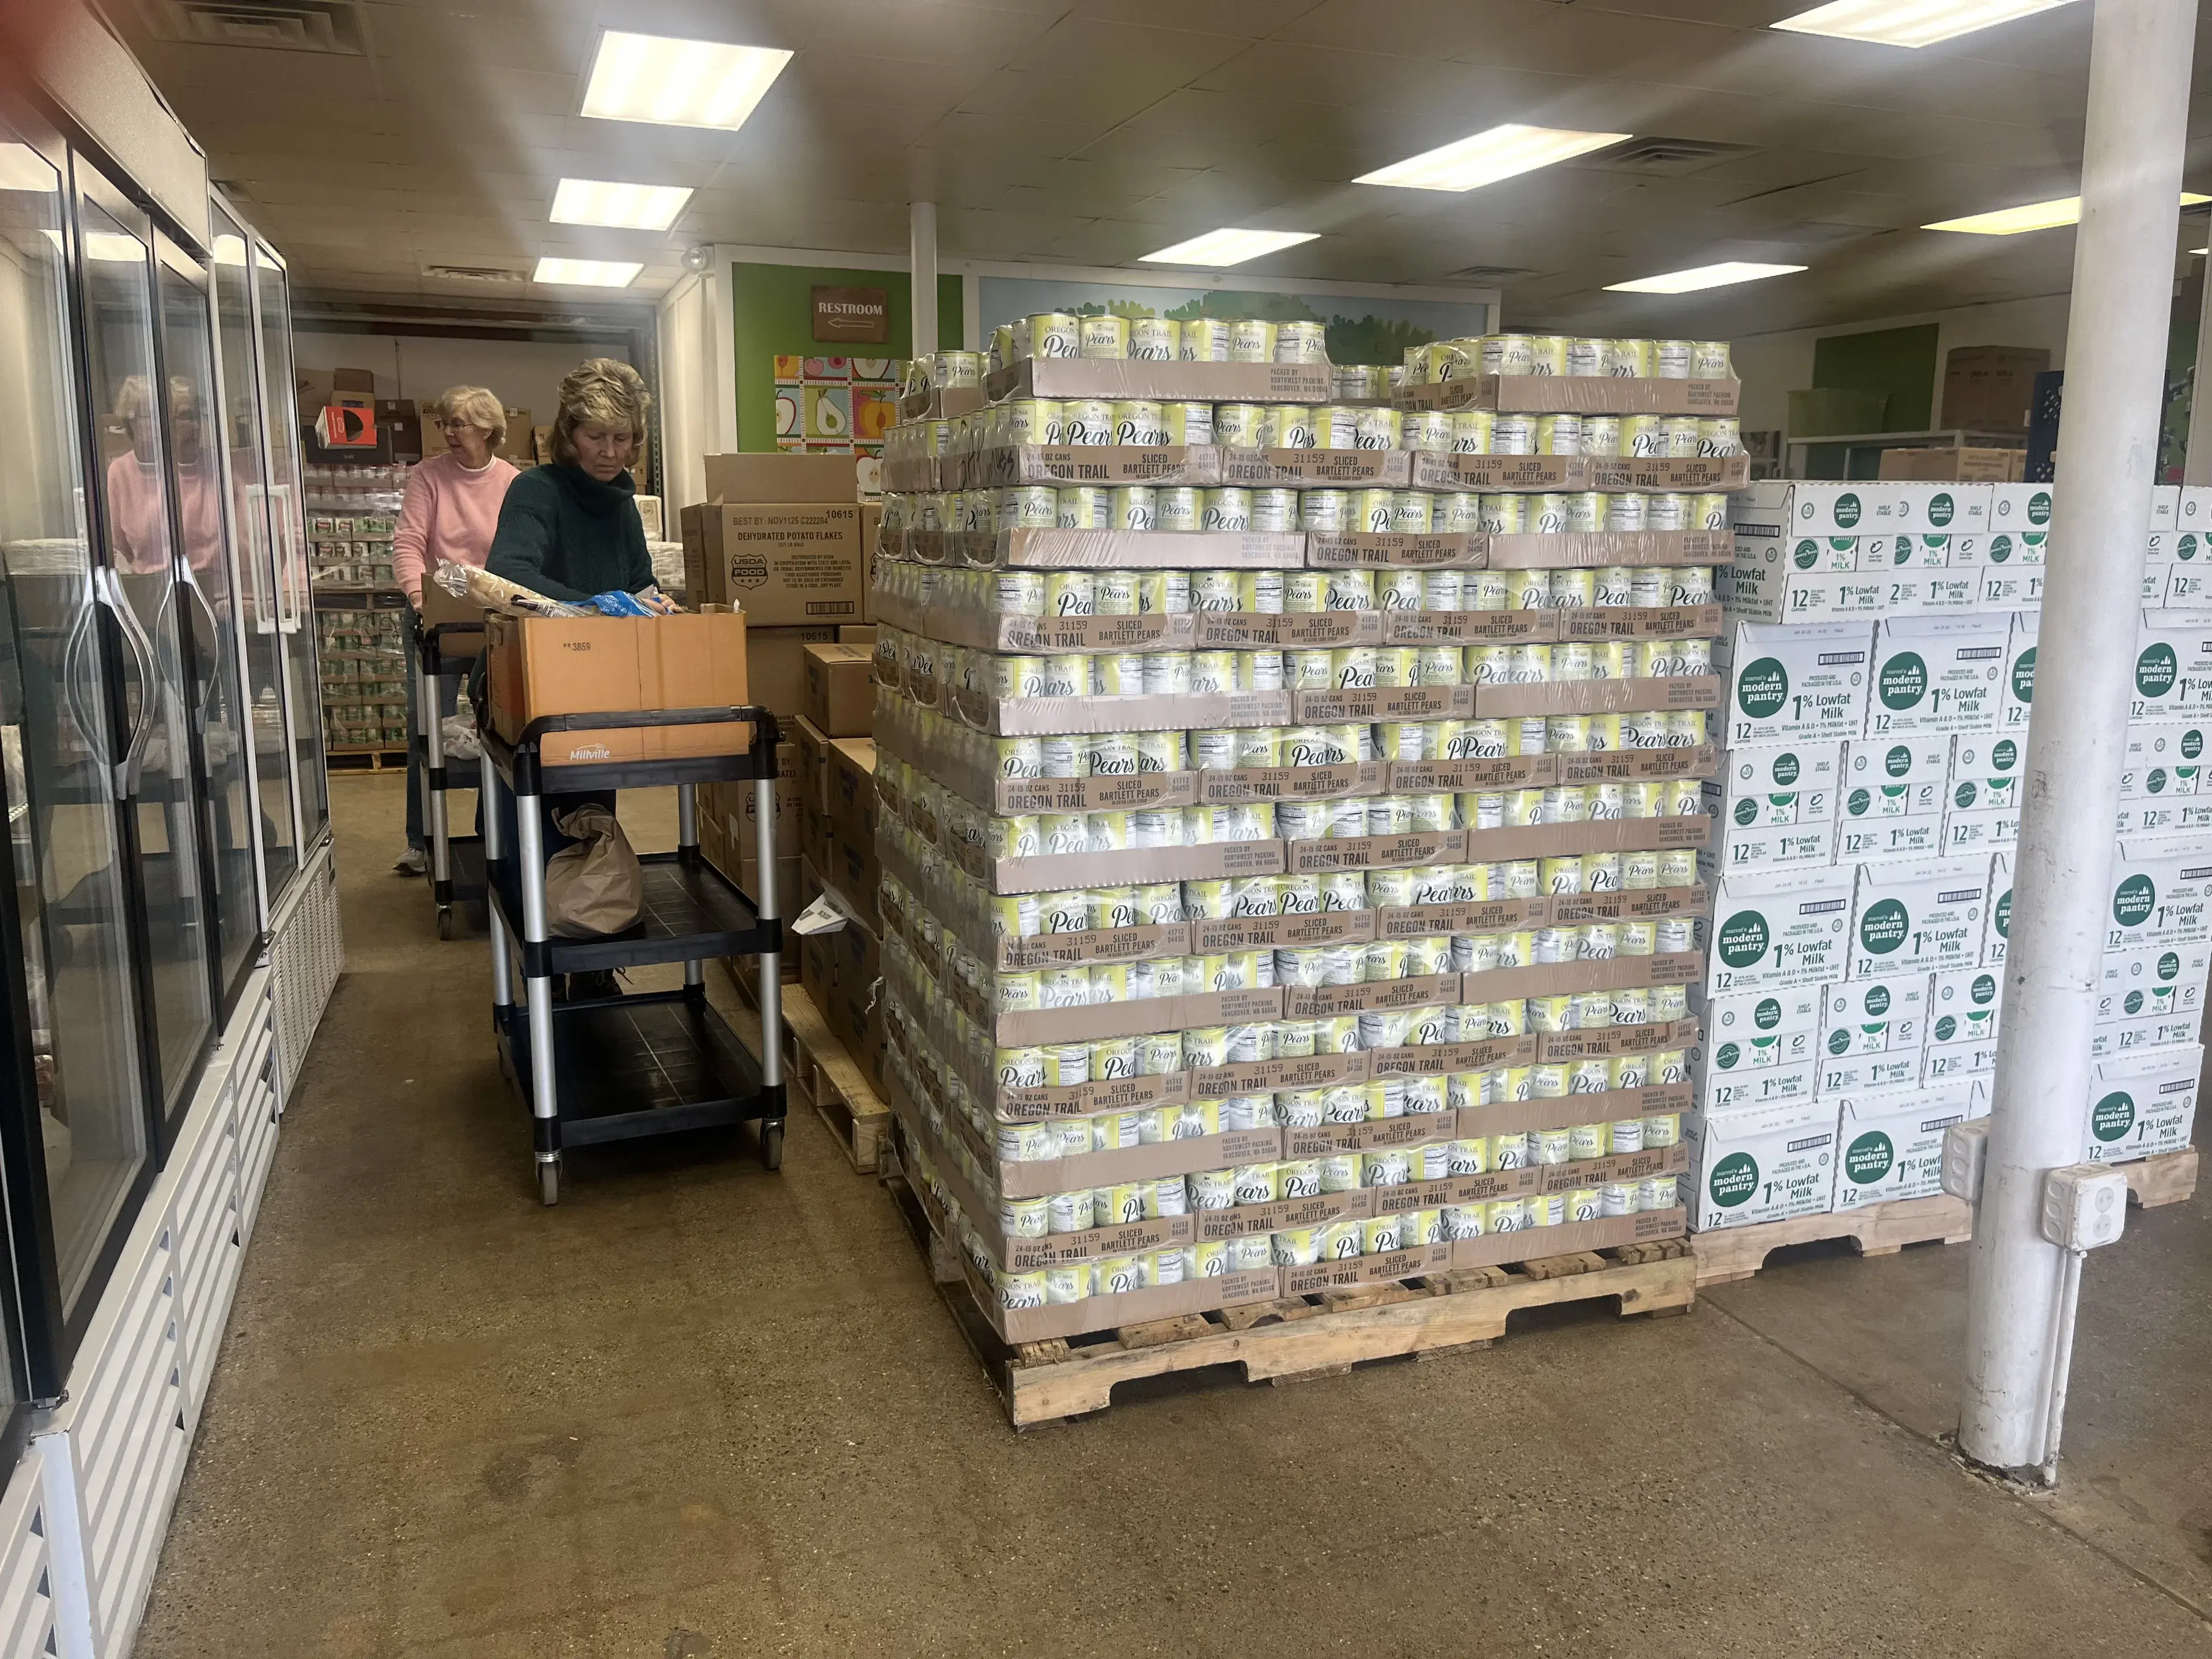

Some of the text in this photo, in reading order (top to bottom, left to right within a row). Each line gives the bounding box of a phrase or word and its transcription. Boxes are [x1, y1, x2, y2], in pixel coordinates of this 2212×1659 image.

[819, 302, 882, 315] RESTROOM
[1045, 326, 1074, 334] OREGON
[1153, 329, 1172, 338] TRAIL
[1086, 332, 1115, 347] Pears
[1232, 337, 1261, 352] Pears
[1216, 420, 1242, 433] Pears
[1142, 454, 1167, 464] SLICED
[1293, 454, 1325, 463] 31159
[1334, 456, 1357, 465] SLICED
[1078, 464, 1109, 479] TRAIL
[1123, 464, 1160, 474] BARTLETT
[1229, 465, 1271, 479] OREGON
[1316, 466, 1374, 476] BARTLETT PEARS
[826, 510, 853, 518] 10615
[733, 517, 752, 525] BEST
[768, 517, 798, 525] NOV1125
[738, 532, 843, 540] DEHYDRATED POTATO FLAKES
[1831, 562, 1849, 570] MILK
[1731, 567, 1766, 581] Lowfat
[1736, 581, 1758, 594] Milk
[1792, 590, 1808, 607] 12
[1840, 586, 1853, 605] 1%
[1855, 586, 1879, 594] Lowfat
[1859, 596, 1874, 604] Milk
[801, 632, 828, 641] 10615
[573, 642, 591, 651] 3859
[1742, 681, 1782, 692] modern
[1747, 691, 1784, 704] pantry
[1793, 694, 1851, 720] 1% Lowfat
[1821, 707, 1843, 719] Milk
[1736, 723, 1751, 738] 12
[570, 748, 610, 761] Millville
[1059, 783, 1085, 792] 31159
[1118, 781, 1141, 790] SLICED
[1100, 789, 1159, 801] BARTLETT PEARS
[1008, 794, 1086, 809] OREGON TRAIL
[1629, 865, 1654, 877] Pears
[2117, 895, 2150, 904] modern
[2120, 904, 2150, 915] pantry
[2158, 903, 2203, 927] 1% Lowfat
[2179, 915, 2197, 926] Milk
[1722, 933, 1763, 944] modern
[2109, 930, 2122, 944] 12
[1728, 942, 1764, 955] pantry
[1774, 939, 1832, 968] 1% Lowfat
[1802, 954, 1824, 965] Milk
[1717, 972, 1732, 988] 12
[1000, 988, 1029, 1004] Pears
[2095, 1112, 2130, 1121] modern
[2099, 1119, 2131, 1131] pantry
[2138, 1115, 2183, 1141] 1% Lowfat
[2160, 1127, 2177, 1139] Milk
[1223, 1143, 1250, 1152] NORTHWEST
[1474, 1177, 1494, 1187] SLICED
[1713, 1173, 1753, 1186] modern
[1429, 1182, 1453, 1192] 31159
[1459, 1183, 1508, 1197] BARTLETT PEARS
[1719, 1181, 1753, 1196] pantry
[1764, 1173, 1820, 1205] 1% Lowfat
[1790, 1187, 1812, 1199] Milk
[1382, 1192, 1447, 1210] OREGON TRAIL
[1708, 1213, 1722, 1227] 12
